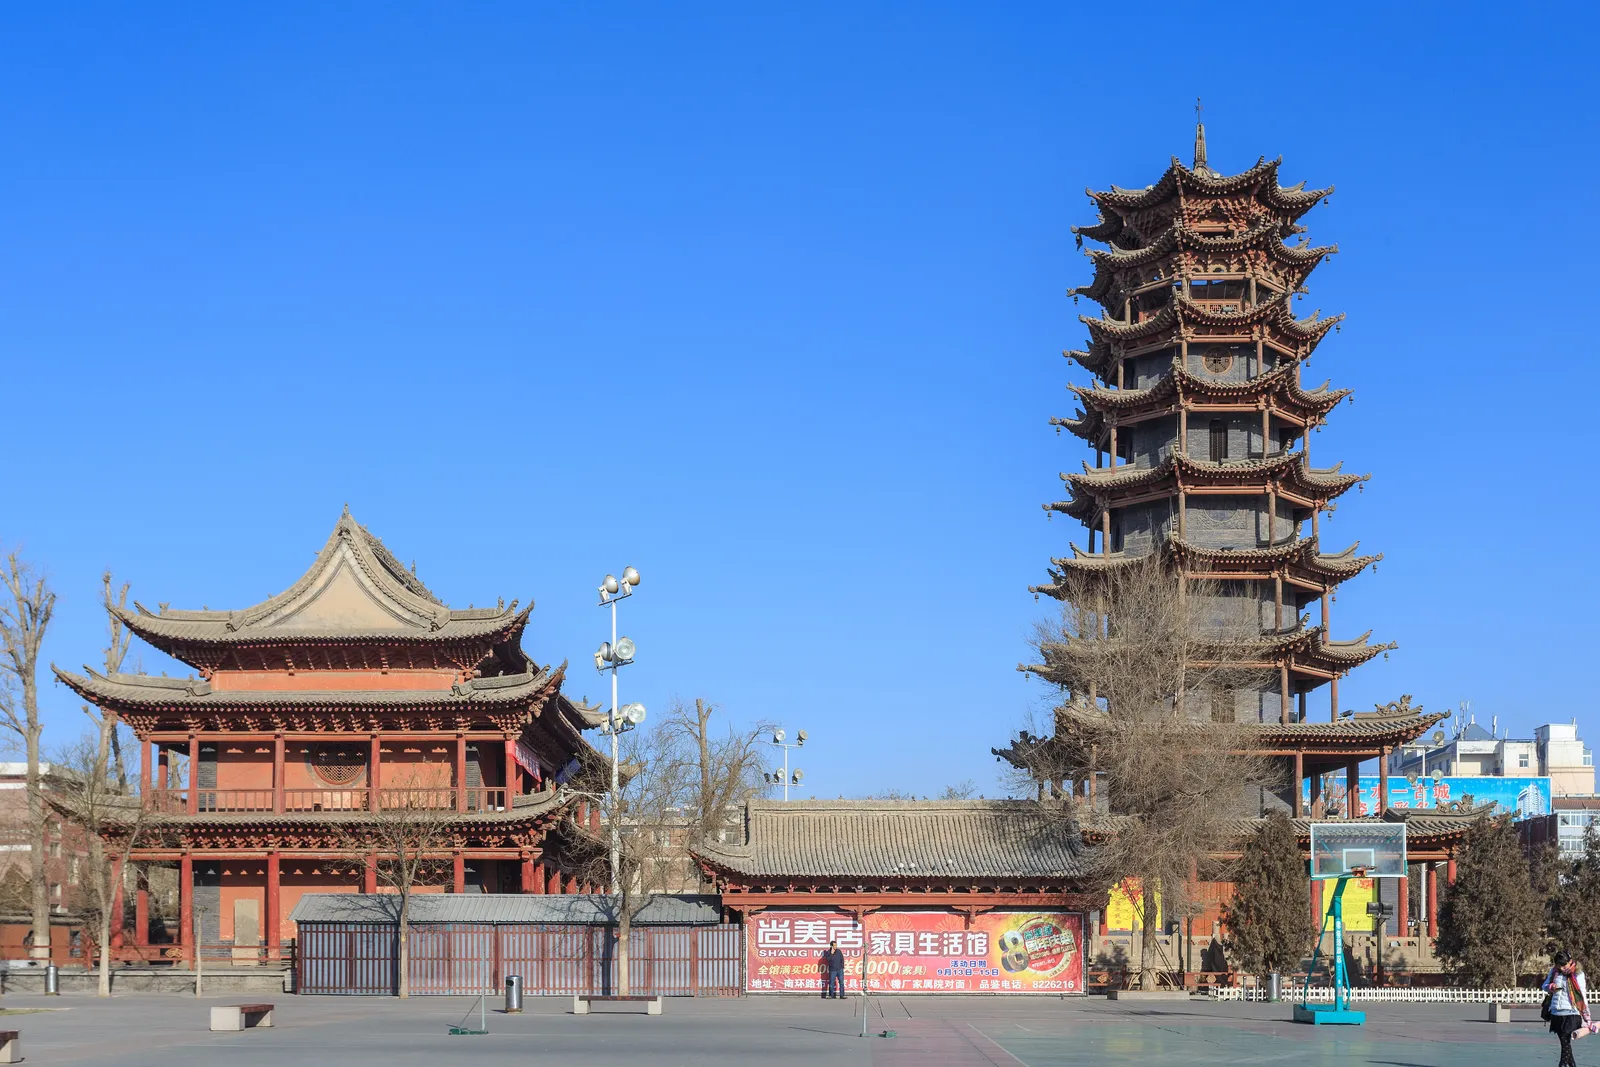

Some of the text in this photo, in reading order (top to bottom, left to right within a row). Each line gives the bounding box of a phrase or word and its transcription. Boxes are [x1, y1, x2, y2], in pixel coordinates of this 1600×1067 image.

[758, 919, 863, 948] 尚美居
[870, 932, 988, 956] 家具生活馆
[758, 949, 808, 957] SHANG
[950, 960, 987, 968] 活动日期
[1032, 980, 1074, 989] 8226216
